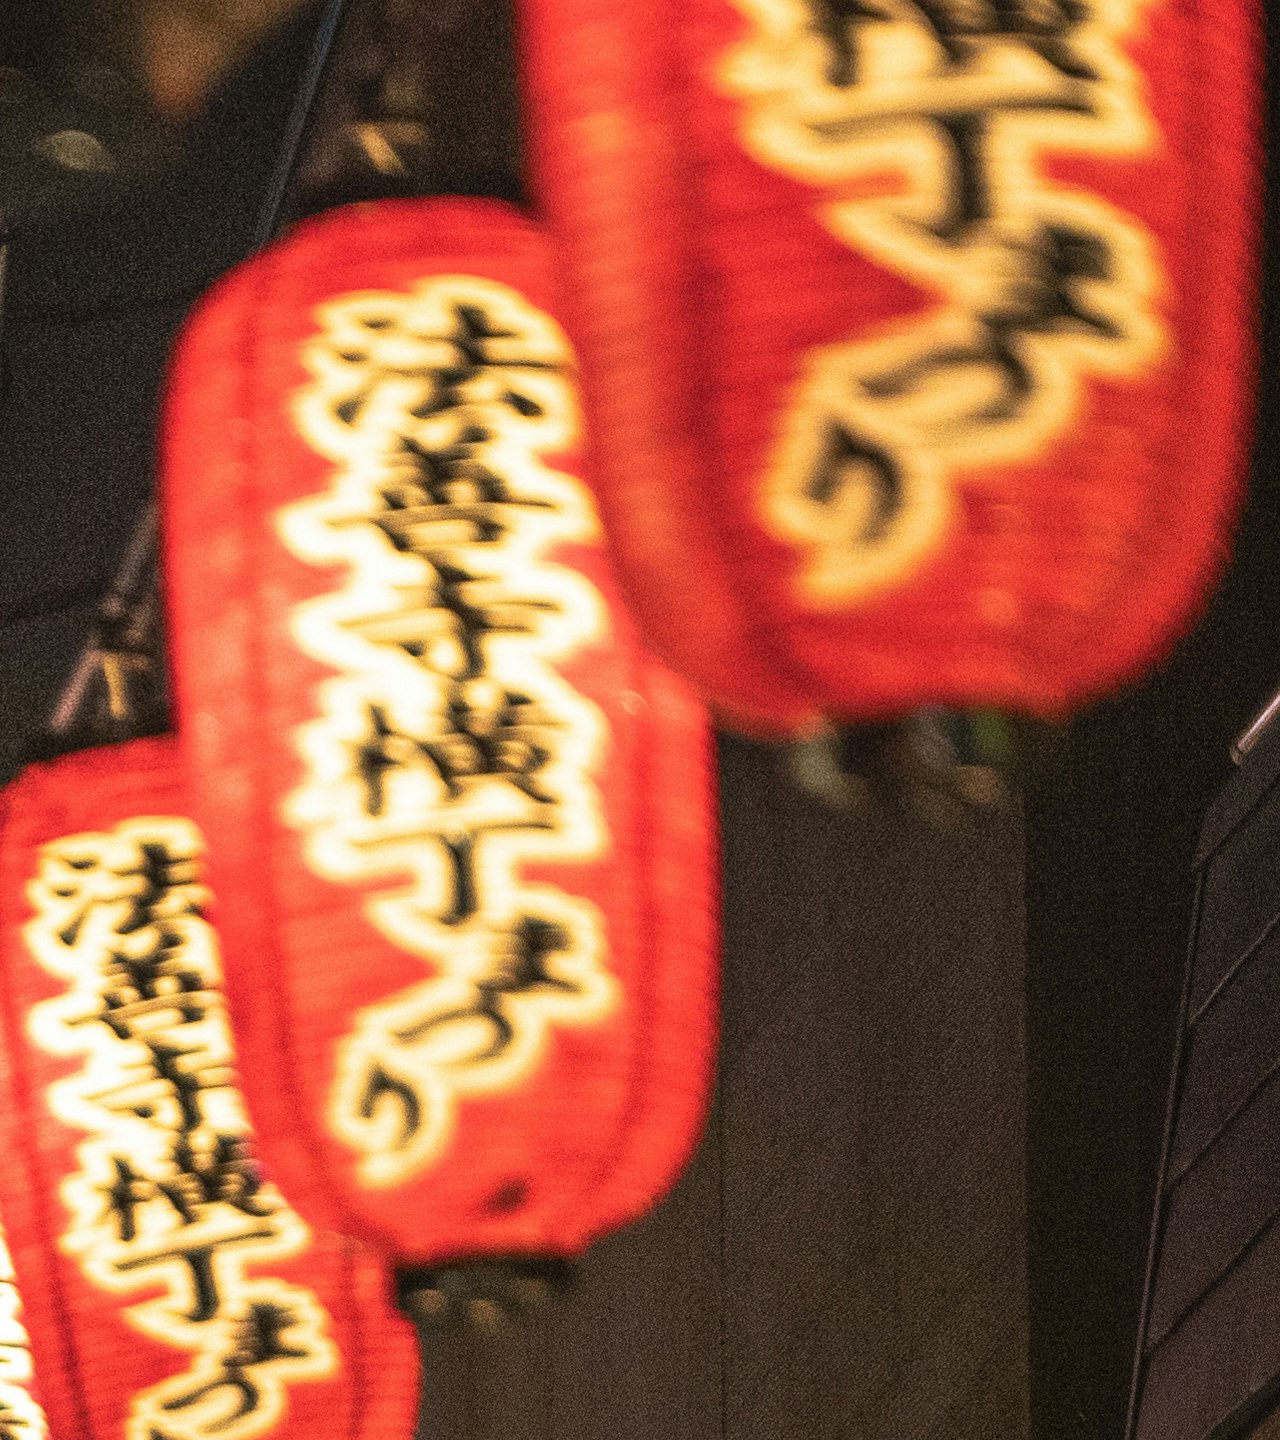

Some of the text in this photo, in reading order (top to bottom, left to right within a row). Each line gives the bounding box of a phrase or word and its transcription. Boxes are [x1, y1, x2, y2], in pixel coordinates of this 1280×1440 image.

[288, 290, 610, 1178] 法善寺横丁まつり
